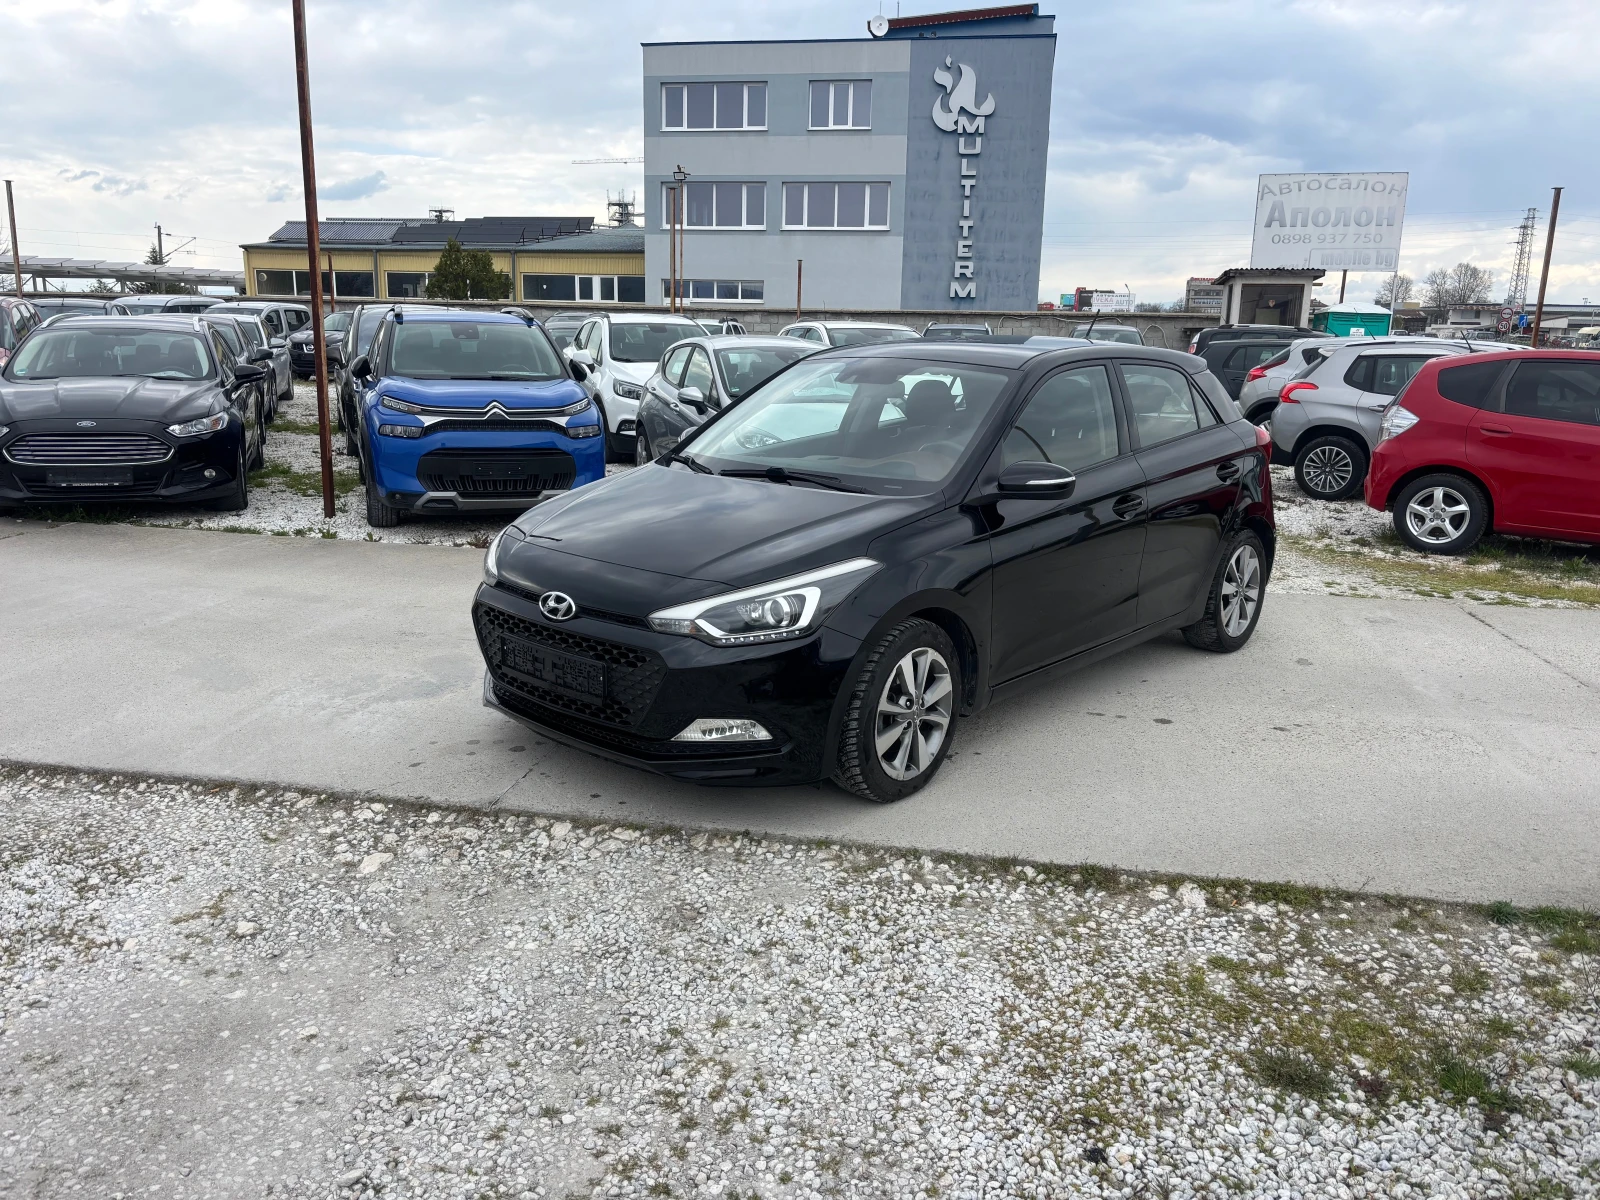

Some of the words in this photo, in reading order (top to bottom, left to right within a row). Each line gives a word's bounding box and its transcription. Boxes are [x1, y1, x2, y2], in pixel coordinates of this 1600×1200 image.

[1260, 178, 1405, 200] Автосалон
[950, 116, 985, 298] MULTITERM
[1264, 200, 1396, 228] Аполон
[1271, 233, 1312, 244] 0898
[1317, 233, 1347, 244] 937
[1353, 233, 1383, 243] 750
